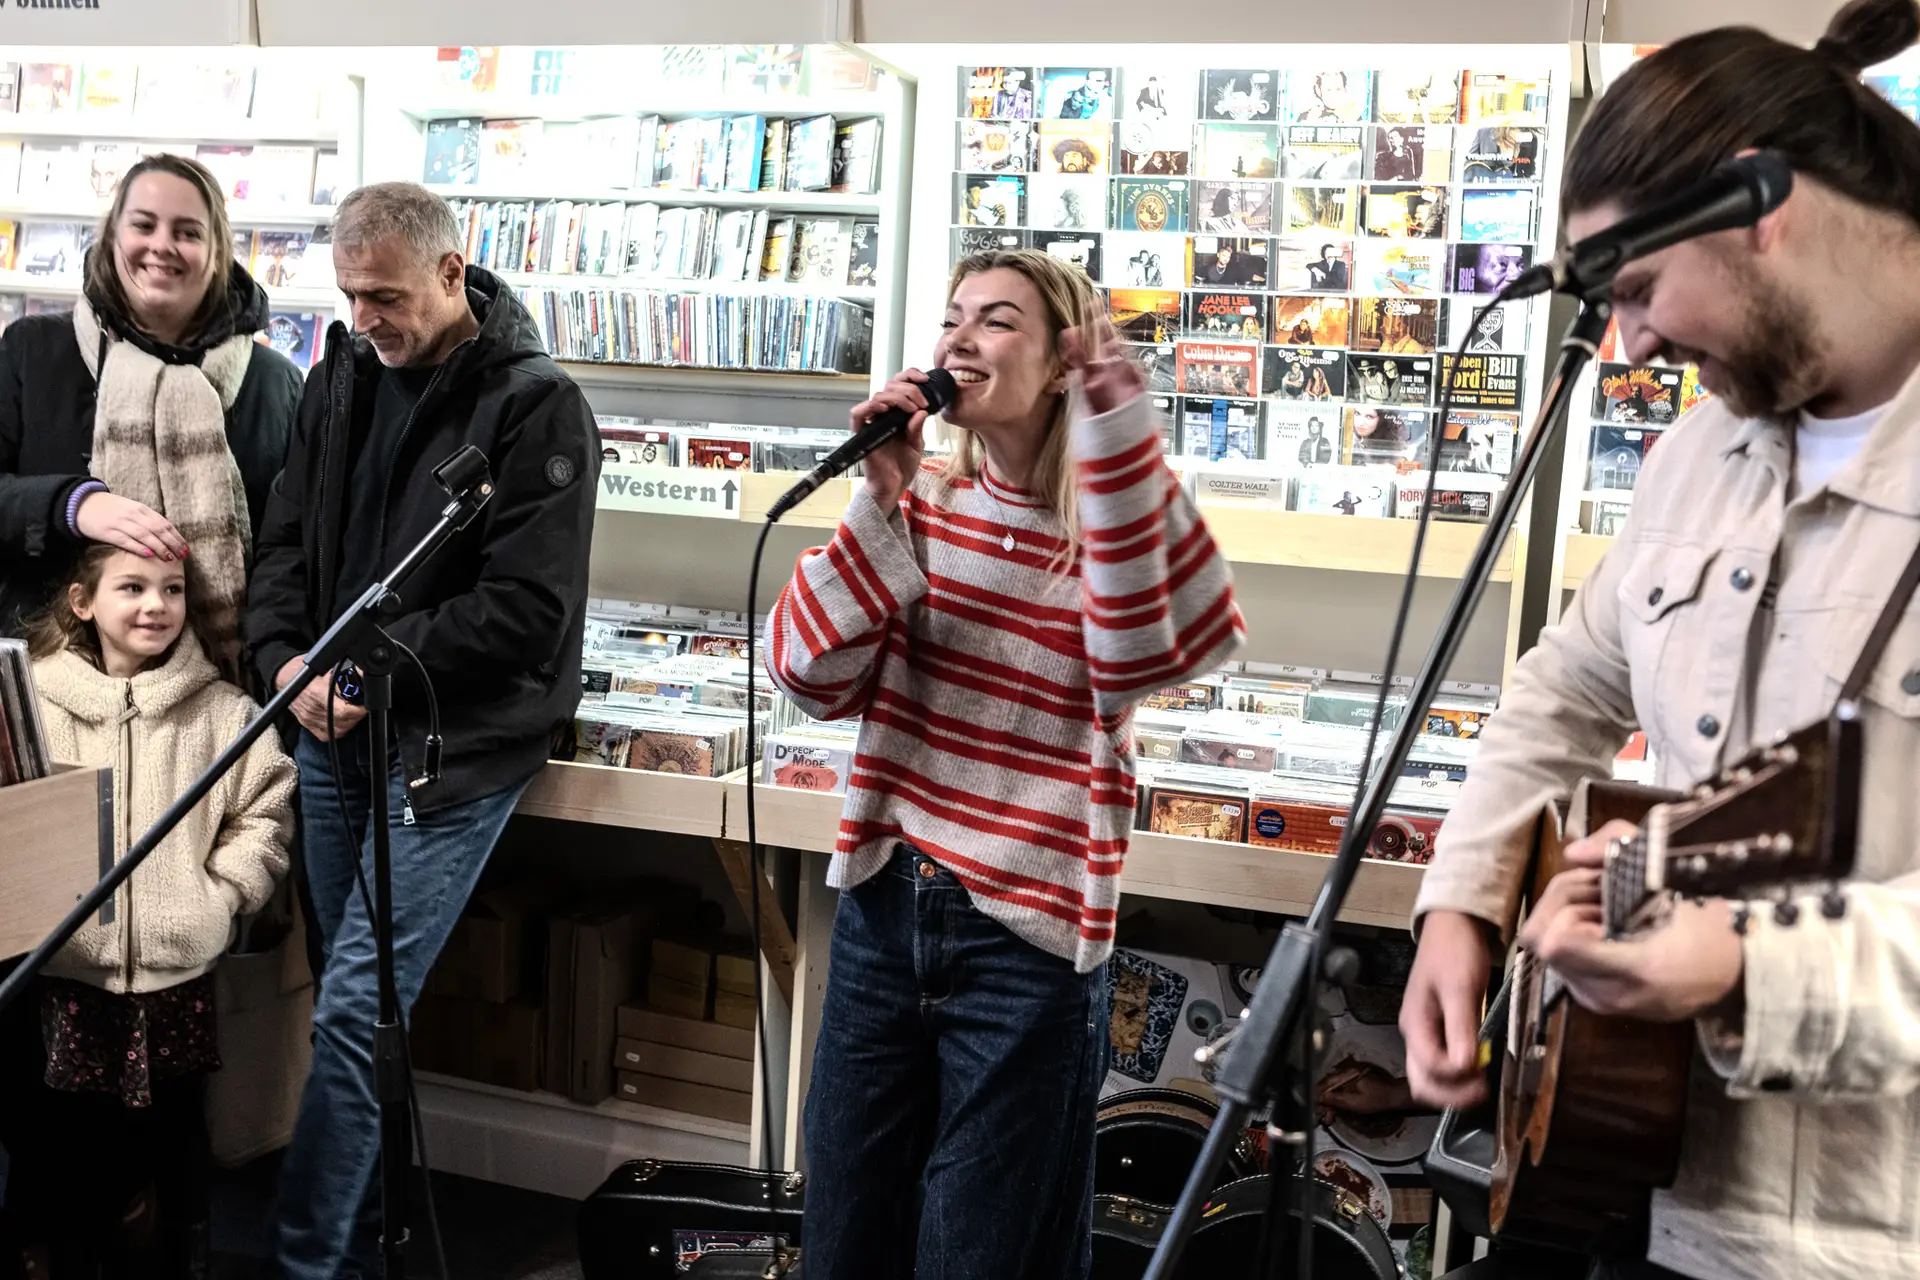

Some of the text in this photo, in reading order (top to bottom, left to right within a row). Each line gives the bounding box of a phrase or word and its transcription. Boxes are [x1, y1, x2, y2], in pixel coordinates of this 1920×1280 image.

[1458, 267, 1475, 290] BIG
[1201, 294, 1250, 306] JANE LEE
[1197, 303, 1241, 316] HOOKE
[1489, 356, 1517, 376] Bill
[1487, 377, 1516, 391] Evans
[600, 474, 717, 503] Western
[1209, 480, 1269, 492] COLTER WALL
[1400, 490, 1426, 502] RORY
[719, 621, 747, 629] CROWDED
[1283, 665, 1297, 673] POP
[1371, 674, 1385, 682] POP
[639, 696, 653, 704] POP
[792, 753, 826, 769] MODE
[1421, 780, 1438, 788] POP
